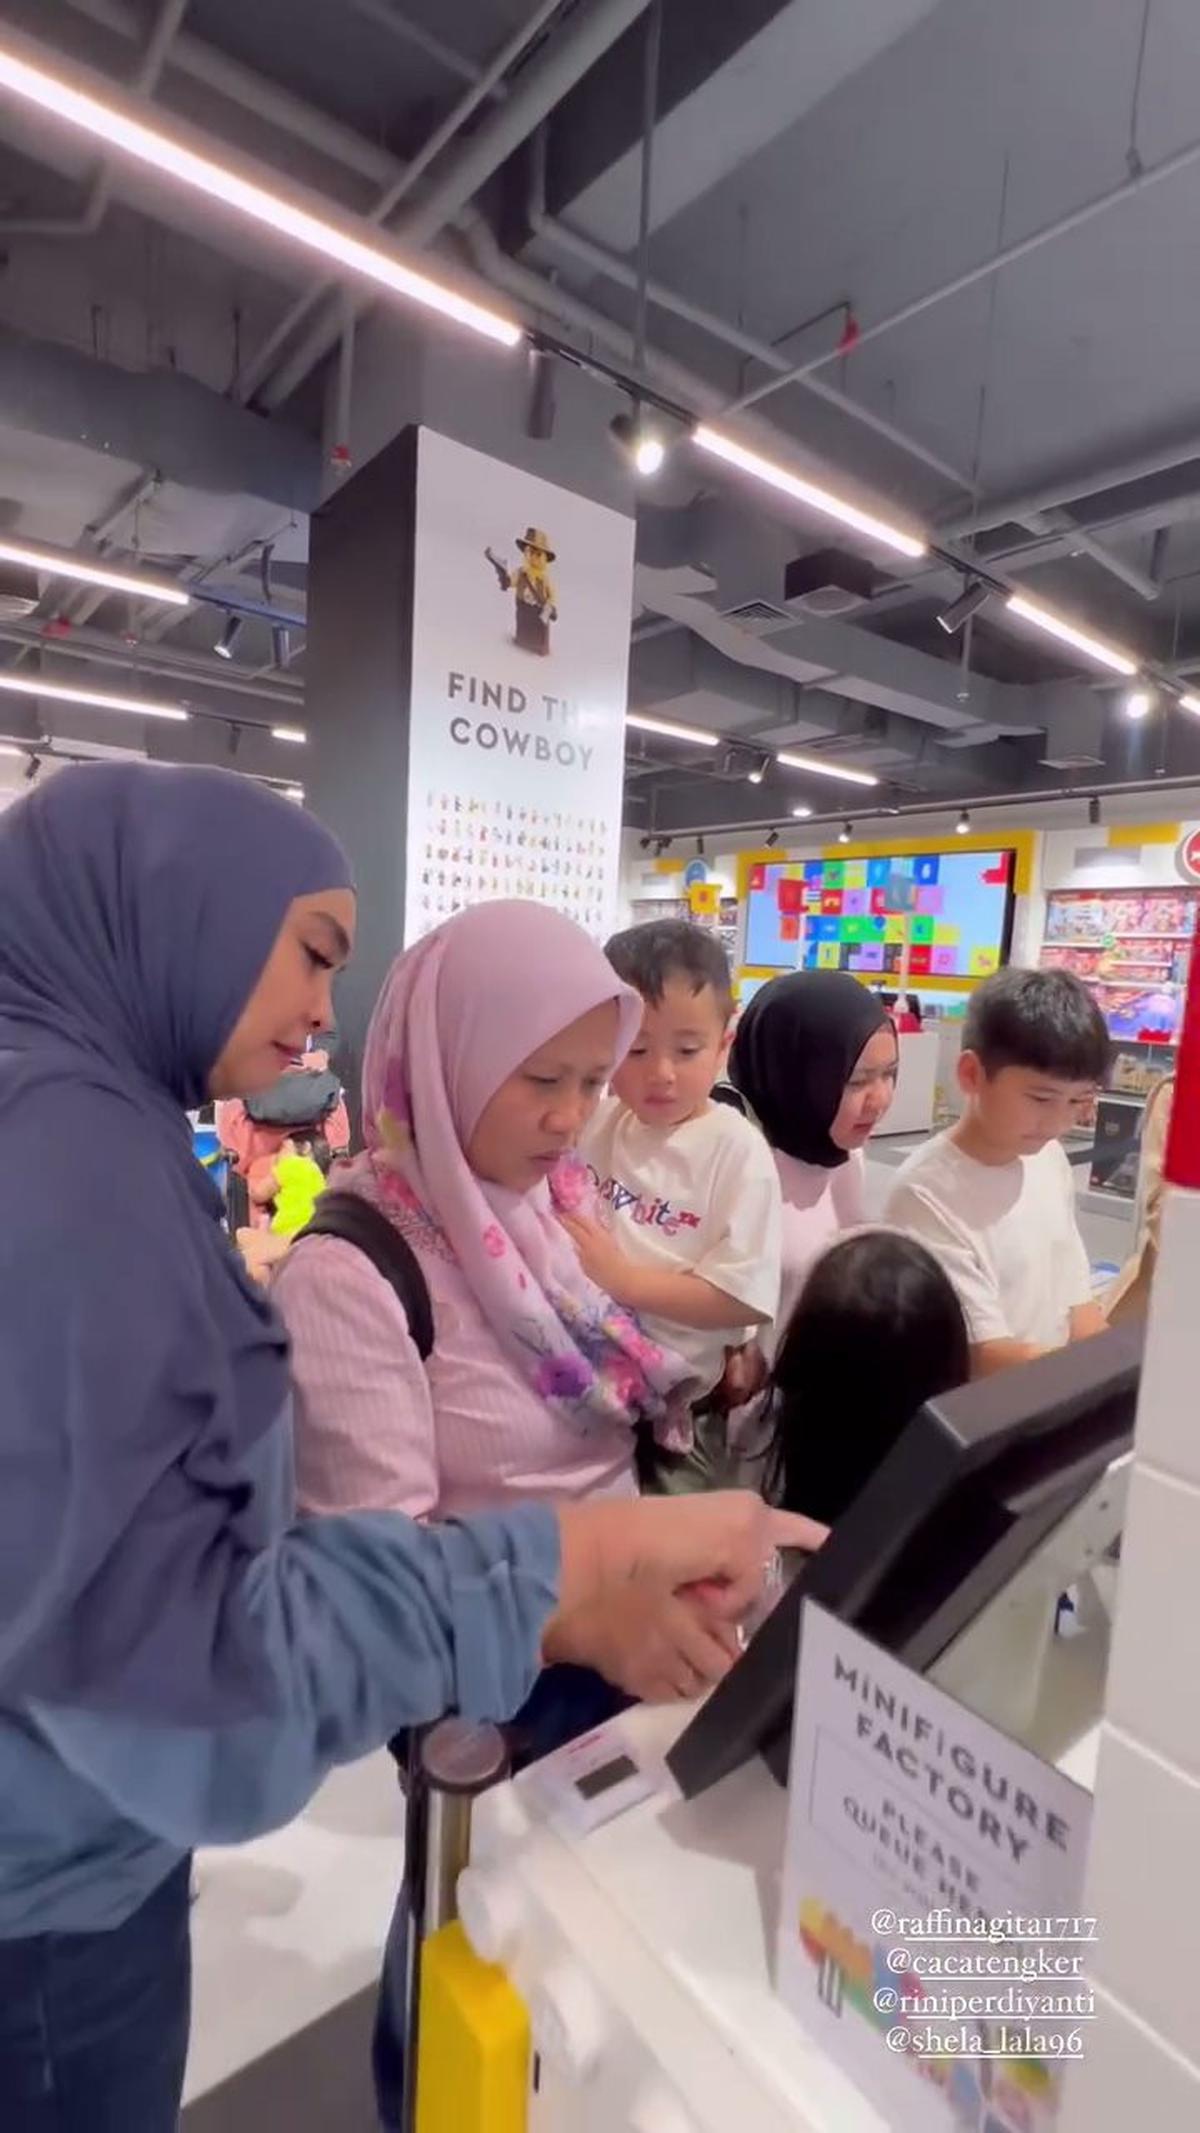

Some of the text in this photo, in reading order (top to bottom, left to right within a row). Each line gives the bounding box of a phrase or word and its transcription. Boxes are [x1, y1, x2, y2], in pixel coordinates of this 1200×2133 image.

[448, 671, 527, 713] FIND
[450, 716, 593, 771] COWBOY
[834, 1652, 1070, 1852] MINIFIGURE
[856, 1711, 1029, 1864] FACTORY
[843, 1795, 926, 1881] QUEUE
[882, 1799, 979, 1894] PLEASE
